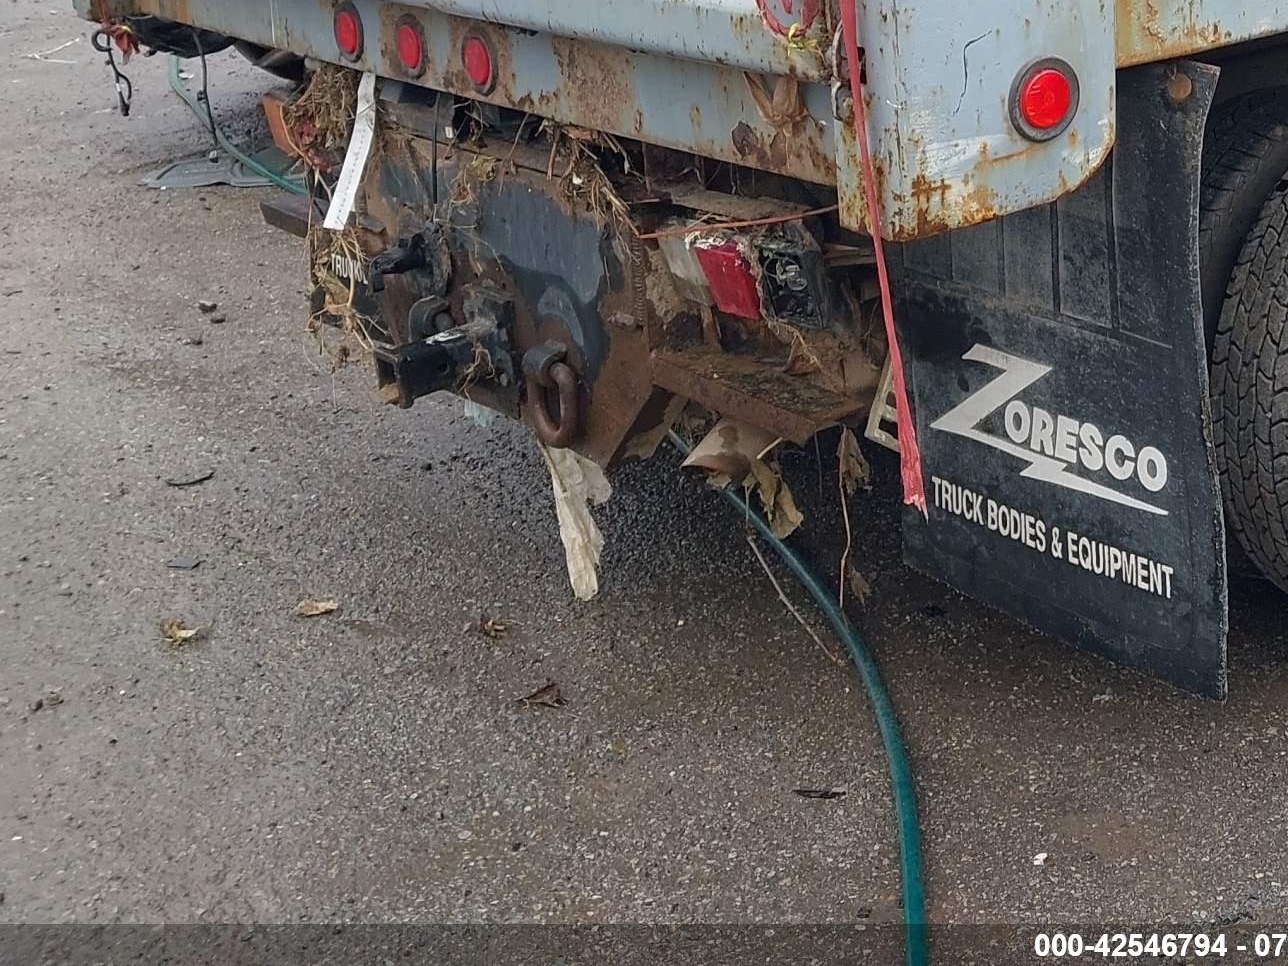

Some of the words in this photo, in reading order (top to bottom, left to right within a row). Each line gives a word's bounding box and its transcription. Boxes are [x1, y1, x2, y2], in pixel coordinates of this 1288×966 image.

[930, 343, 1168, 512] ZORESCO
[931, 476, 984, 525] TRUCK
[987, 498, 1047, 552] BODIES
[1051, 527, 1063, 560] &
[1067, 532, 1174, 599] EQUIPMENT
